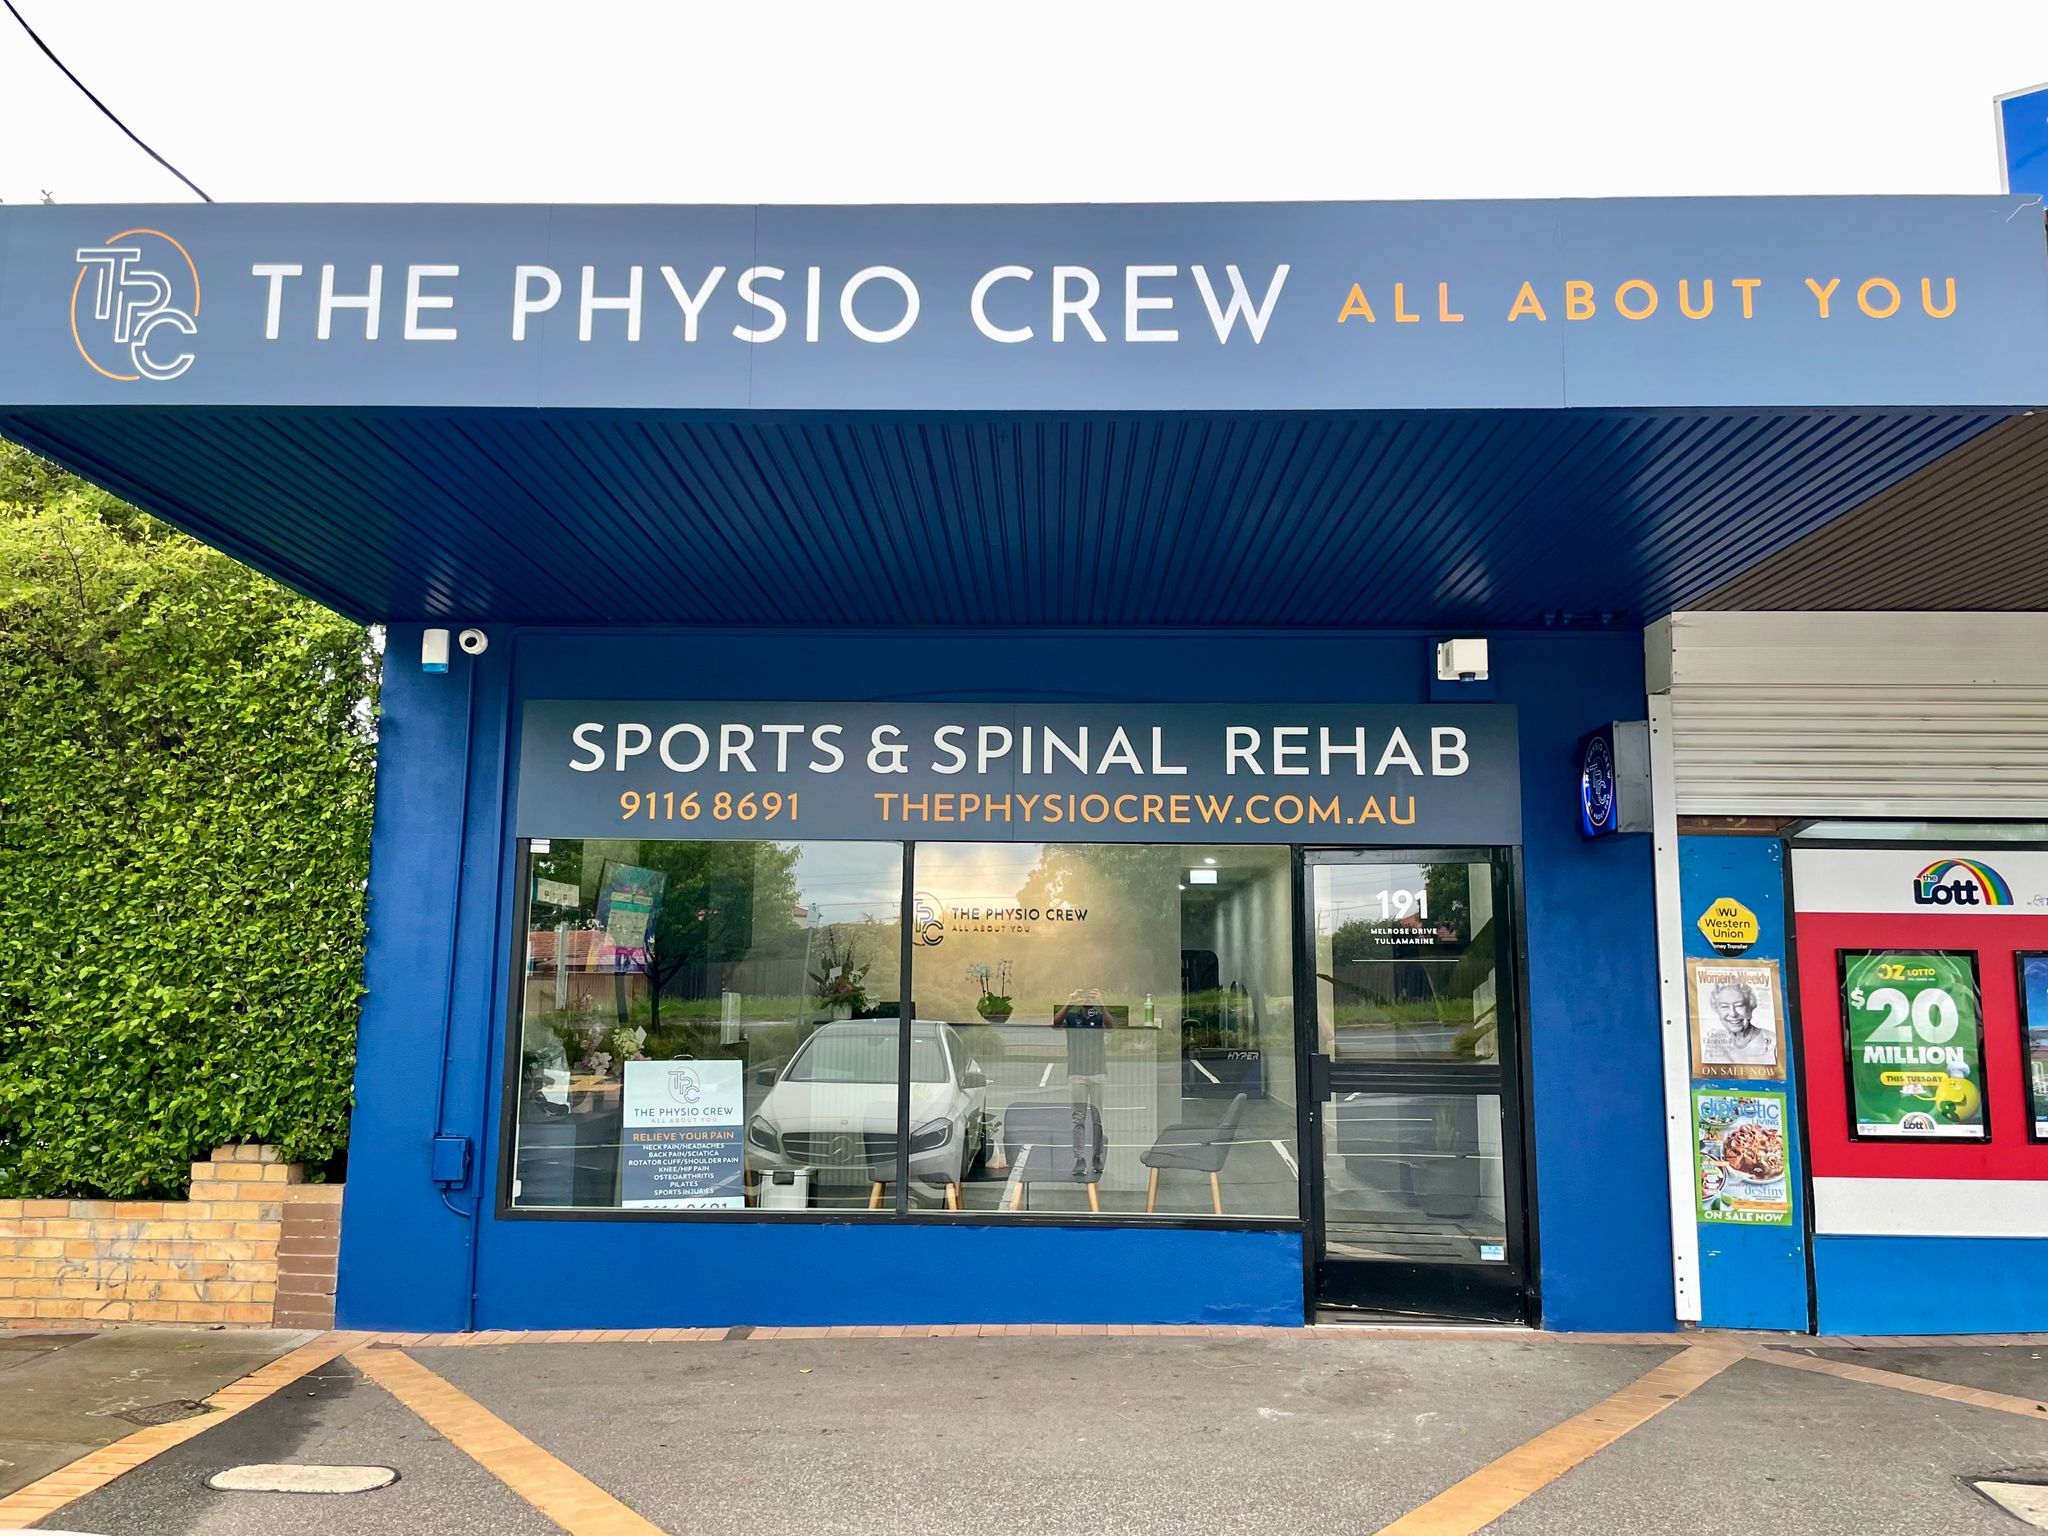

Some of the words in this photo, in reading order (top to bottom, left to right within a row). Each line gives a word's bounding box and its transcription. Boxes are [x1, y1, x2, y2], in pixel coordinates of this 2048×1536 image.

[252, 264, 460, 341] THE
[512, 264, 921, 344] PHYSIO
[969, 263, 1291, 345] CREW
[1337, 281, 1465, 323] ALL
[1507, 278, 1762, 321] ABOUT
[1805, 277, 1958, 319] YOU
[568, 722, 846, 774] SPORTS
[866, 725, 909, 775] &
[930, 725, 1188, 776] SPINAL
[1225, 726, 1470, 777] REHAB
[620, 791, 701, 821] 9116
[712, 791, 799, 822] 8691
[874, 792, 1417, 826] THEPHYSIOCREW.COM.AU
[1922, 873, 1937, 882] the
[1913, 878, 1980, 905] Lott
[1375, 889, 1428, 920] 191
[951, 907, 980, 920] THE
[986, 908, 1040, 921] PHYSIO
[1045, 908, 1088, 921] CREW
[1717, 908, 1737, 917] WU
[1704, 918, 1751, 928] Western
[951, 924, 969, 933] ALL
[973, 924, 1006, 933] ABOUT
[1010, 924, 1031, 933] YOU
[1712, 928, 1744, 938] Union
[1374, 937, 1434, 945] TULLAMARINE
[1876, 963, 1906, 981] OZ
[1907, 968, 1936, 977] LOTTO
[1697, 970, 1736, 985] Women's
[1736, 971, 1770, 987] Weekly
[1227, 1051, 1259, 1061] HYPER
[1863, 1045, 1964, 1065] MILLION
[1701, 1066, 1718, 1075] ON
[1720, 1066, 1746, 1076] SALE
[1751, 1067, 1777, 1076] NOW
[1885, 1075, 1905, 1083] THIS
[1906, 1075, 1943, 1083] TUESDAY
[634, 1108, 655, 1117] THE
[659, 1107, 700, 1117] PHYSIO
[703, 1107, 734, 1116] CREW
[1700, 1097, 1780, 1120] diabetic
[1751, 1118, 1780, 1126] LIVING
[633, 1133, 677, 1142] RELIEVE
[679, 1132, 708, 1141] YOUR
[710, 1131, 734, 1140] PAIN
[663, 1143, 725, 1151] PAIN/HEADACHES
[668, 1150, 719, 1158] PAIN/SCIATICA
[662, 1158, 722, 1166] CUFF/SHOULDER
[653, 1173, 715, 1181] OSTEOARTHRITIS
[653, 1188, 682, 1196] SPORTS
[682, 1187, 714, 1196] INJURIES
[1704, 1210, 1723, 1220] ON
[1724, 1211, 1753, 1222] SALE
[1755, 1212, 1784, 1222] NOW
